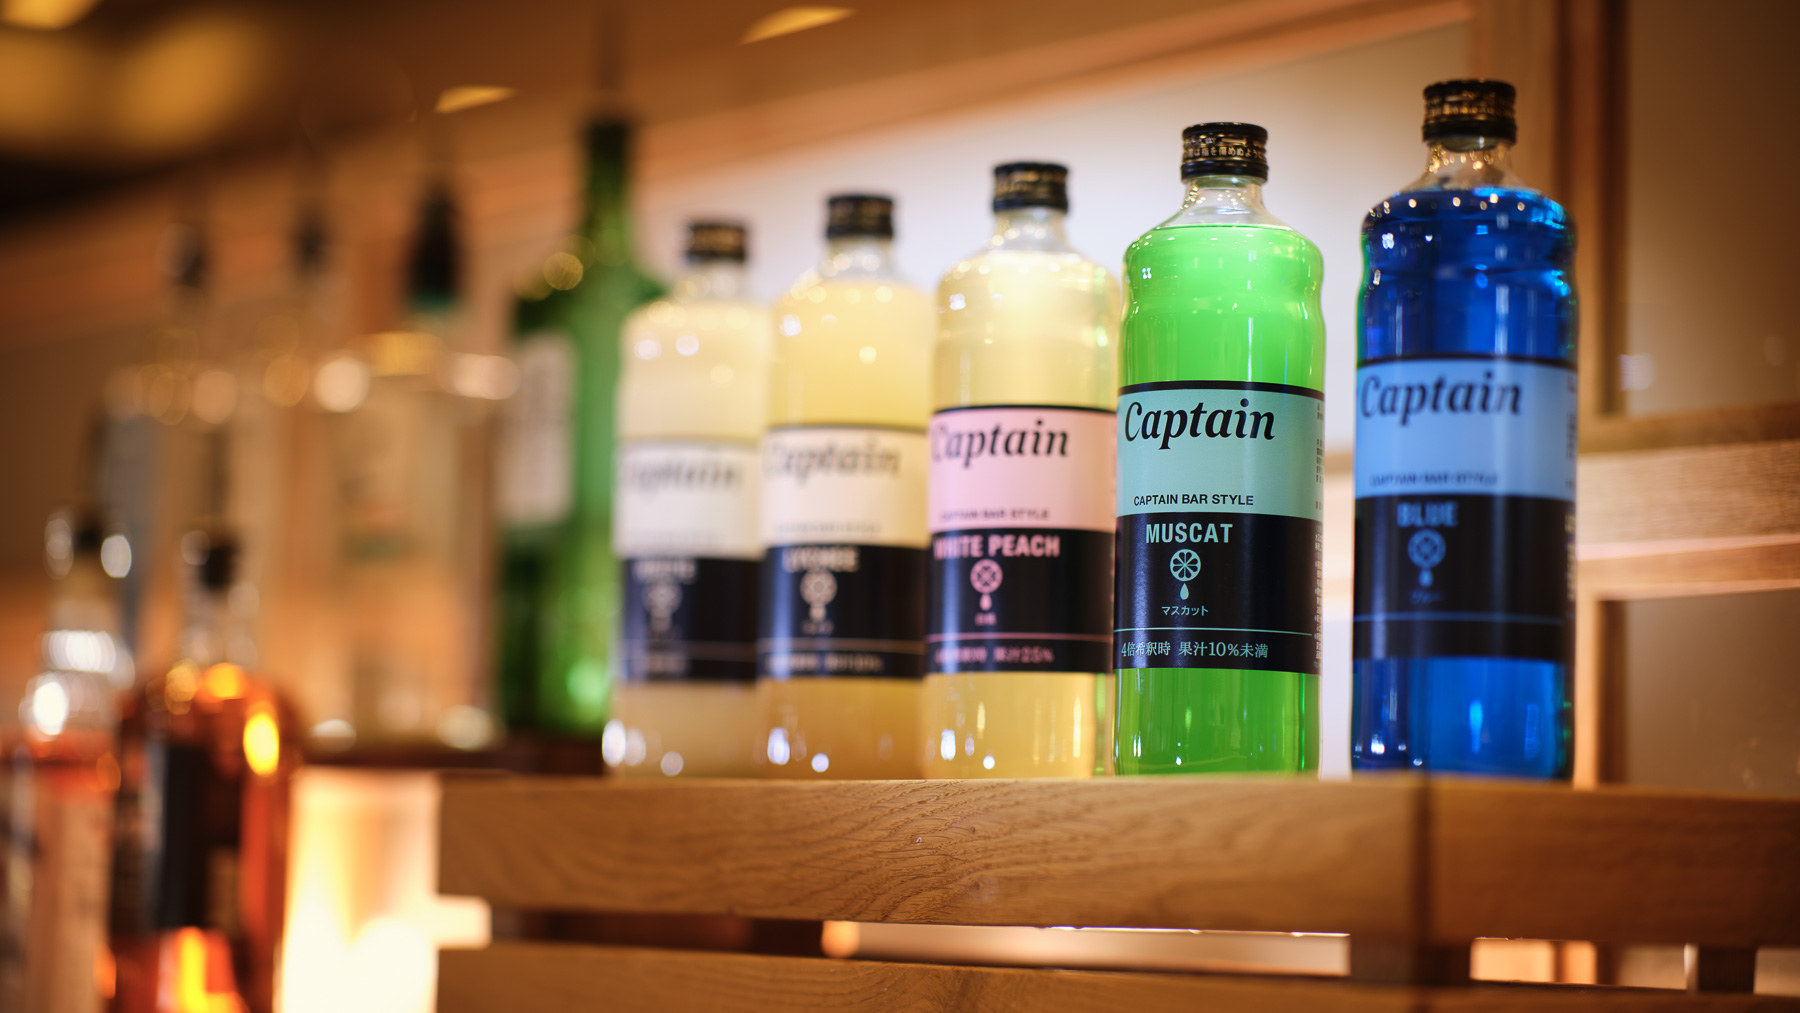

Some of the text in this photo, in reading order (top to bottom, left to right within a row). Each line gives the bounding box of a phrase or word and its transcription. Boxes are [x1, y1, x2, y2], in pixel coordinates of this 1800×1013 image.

[1361, 369, 1524, 426] Captain
[1125, 398, 1275, 450] Captain
[931, 419, 1070, 469] Captain
[1134, 494, 1254, 506] CAPTAIN BAR STYLE
[1396, 501, 1459, 527] BLUE
[1145, 523, 1233, 543] MUSCAT
[933, 534, 1061, 560] WHITE PEACH
[1161, 605, 1209, 617] マスカット
[1121, 641, 1269, 658] 4倍希釈時 果汁10%未満
